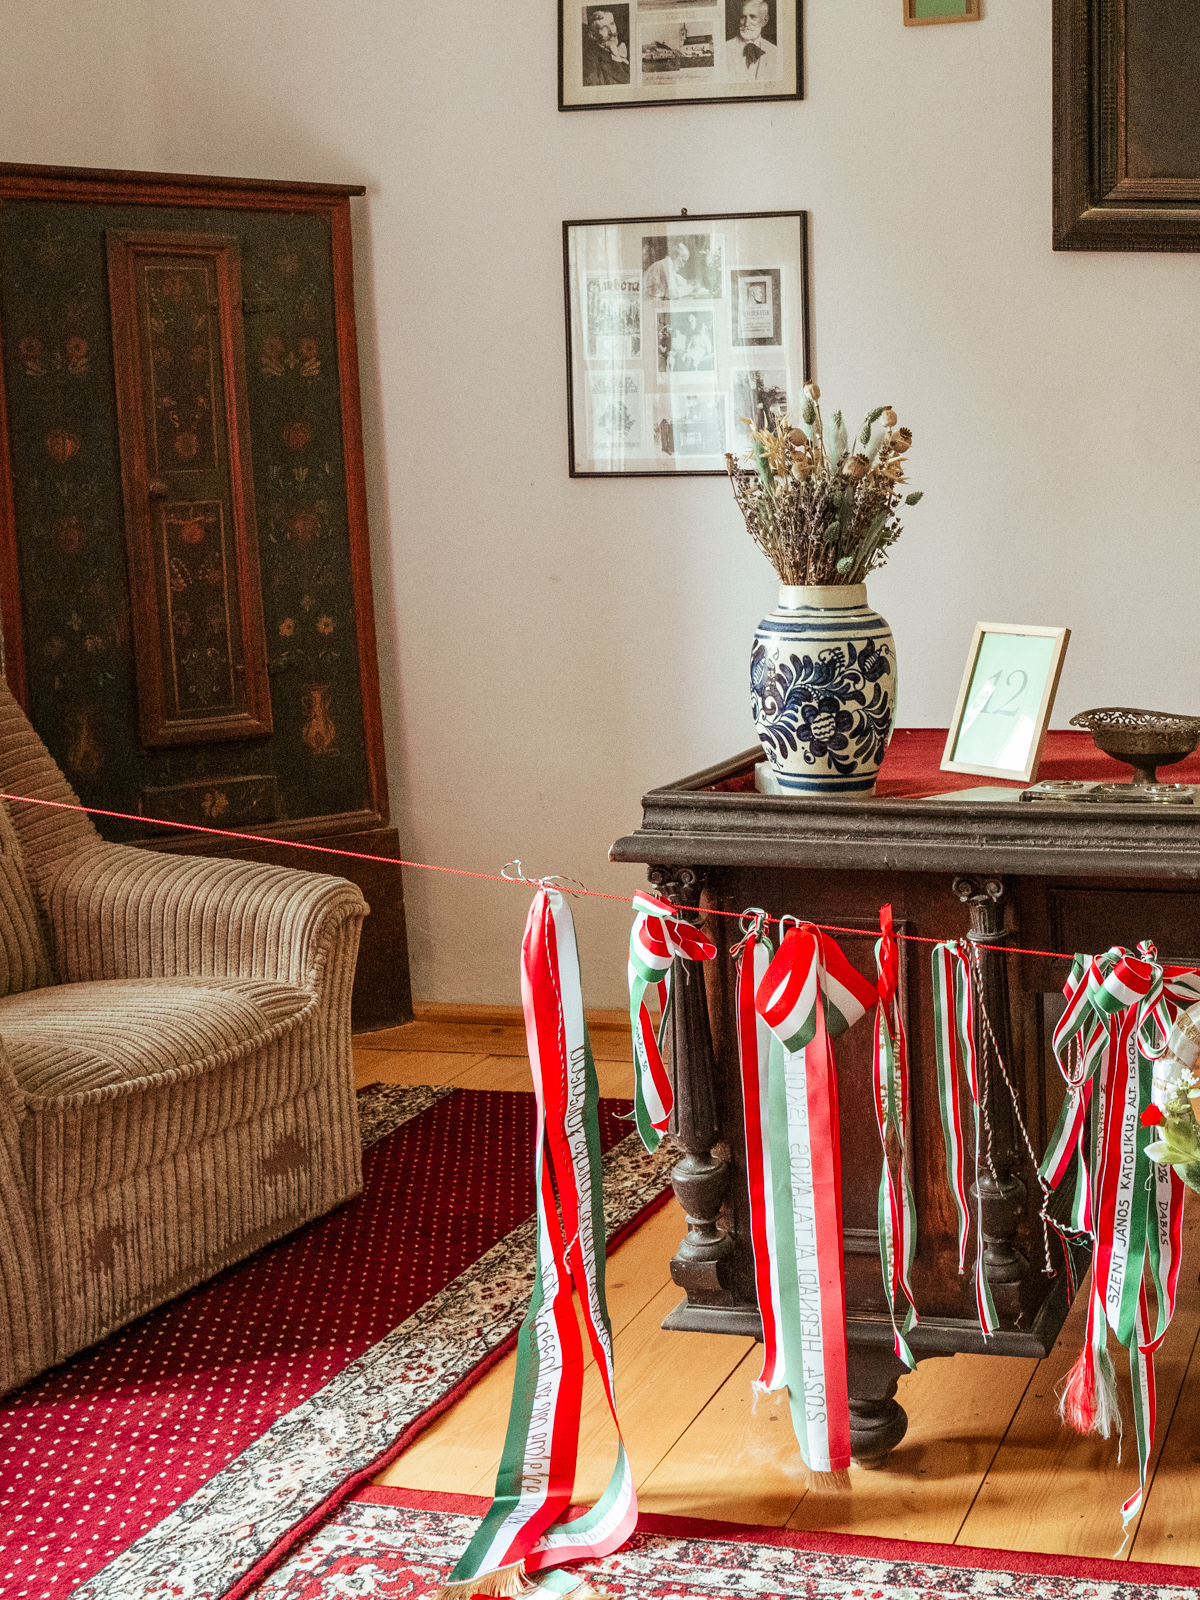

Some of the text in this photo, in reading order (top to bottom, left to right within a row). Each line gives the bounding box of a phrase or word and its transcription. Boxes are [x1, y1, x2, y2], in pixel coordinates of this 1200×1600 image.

[979, 668, 1029, 717] 12
[1107, 1032, 1138, 1308] SZENT JÁNOS KATOLIKUS ÁLT. ISKOLA
[1158, 1201, 1170, 1246] DABAS
